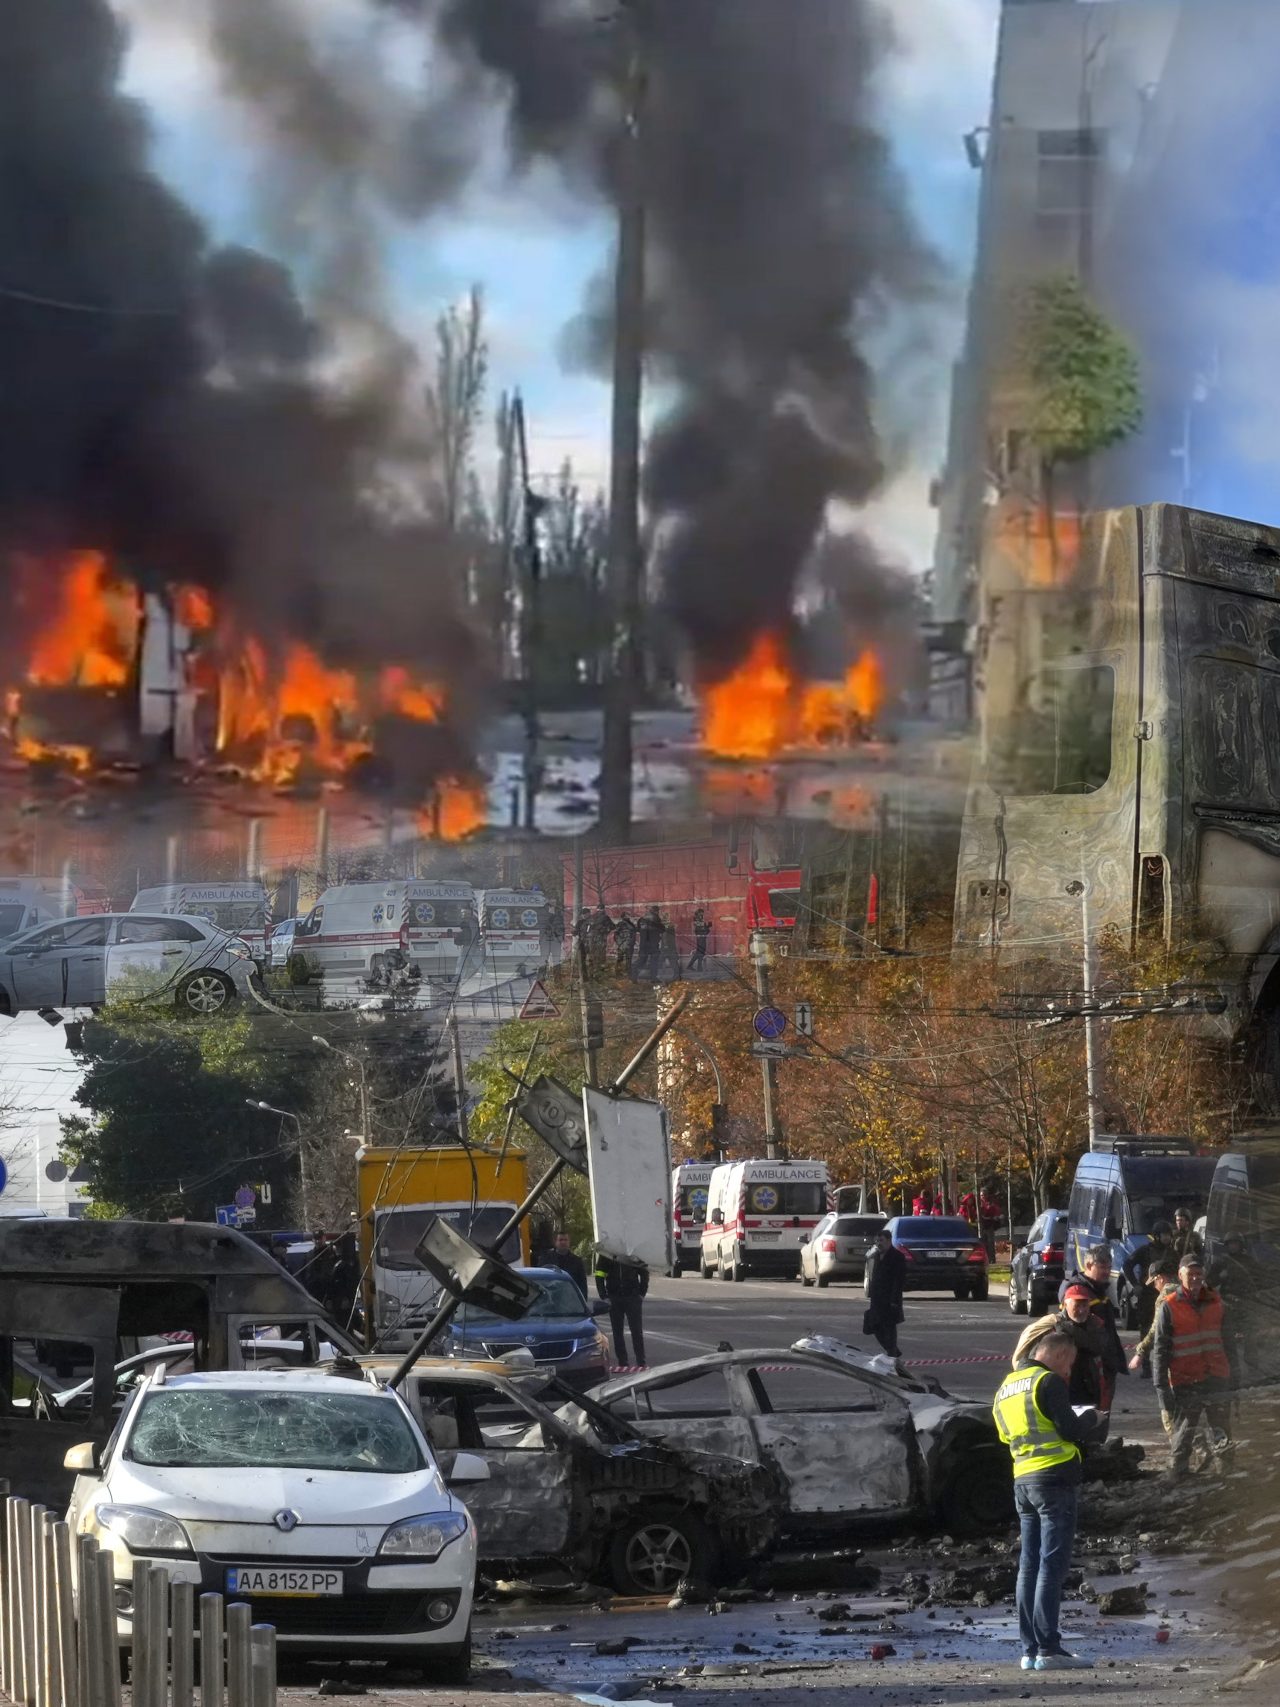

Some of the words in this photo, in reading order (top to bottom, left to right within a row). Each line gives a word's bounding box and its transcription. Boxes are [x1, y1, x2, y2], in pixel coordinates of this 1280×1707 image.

[191, 890, 260, 899] AMBULANCE
[412, 888, 468, 897] AMBULANCE
[489, 896, 541, 904] AMBULANCE
[750, 1169, 821, 1179] AMBULANCE
[239, 1572, 265, 1590] AA
[268, 1572, 308, 1590] 8152
[312, 1573, 338, 1591] PP
